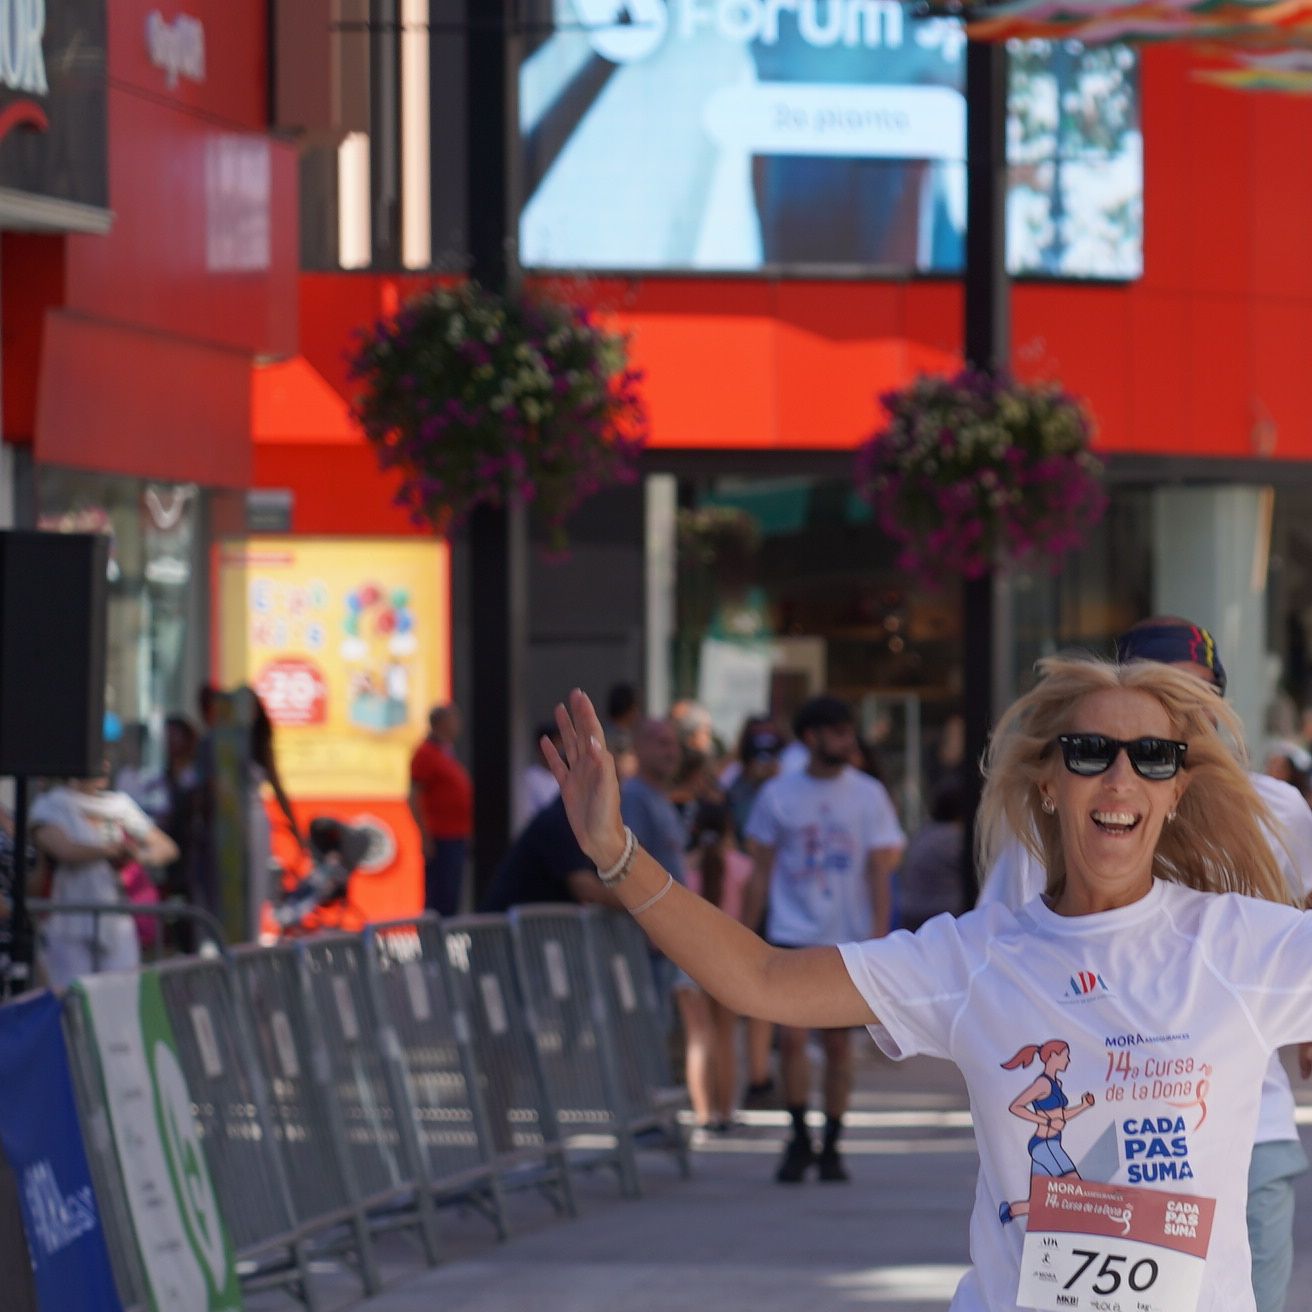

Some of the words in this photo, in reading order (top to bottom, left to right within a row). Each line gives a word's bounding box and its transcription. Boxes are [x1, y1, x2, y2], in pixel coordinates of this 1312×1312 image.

[679, 0, 902, 48] Forum
[1105, 1033, 1145, 1048] MORA
[1144, 1057, 1195, 1079] Cursa
[1105, 1083, 1125, 1102] de
[1132, 1081, 1149, 1101] la
[1152, 1079, 1192, 1099] Dona
[1123, 1115, 1186, 1135] CADA
[1124, 1137, 1188, 1160] PAS
[1128, 1160, 1194, 1184] SUMA
[1048, 1181, 1083, 1197] MORA
[1167, 1200, 1200, 1215] CADA
[1165, 1211, 1199, 1226] PAS
[1164, 1223, 1197, 1238] SUMA
[1063, 1249, 1159, 1295] 750
